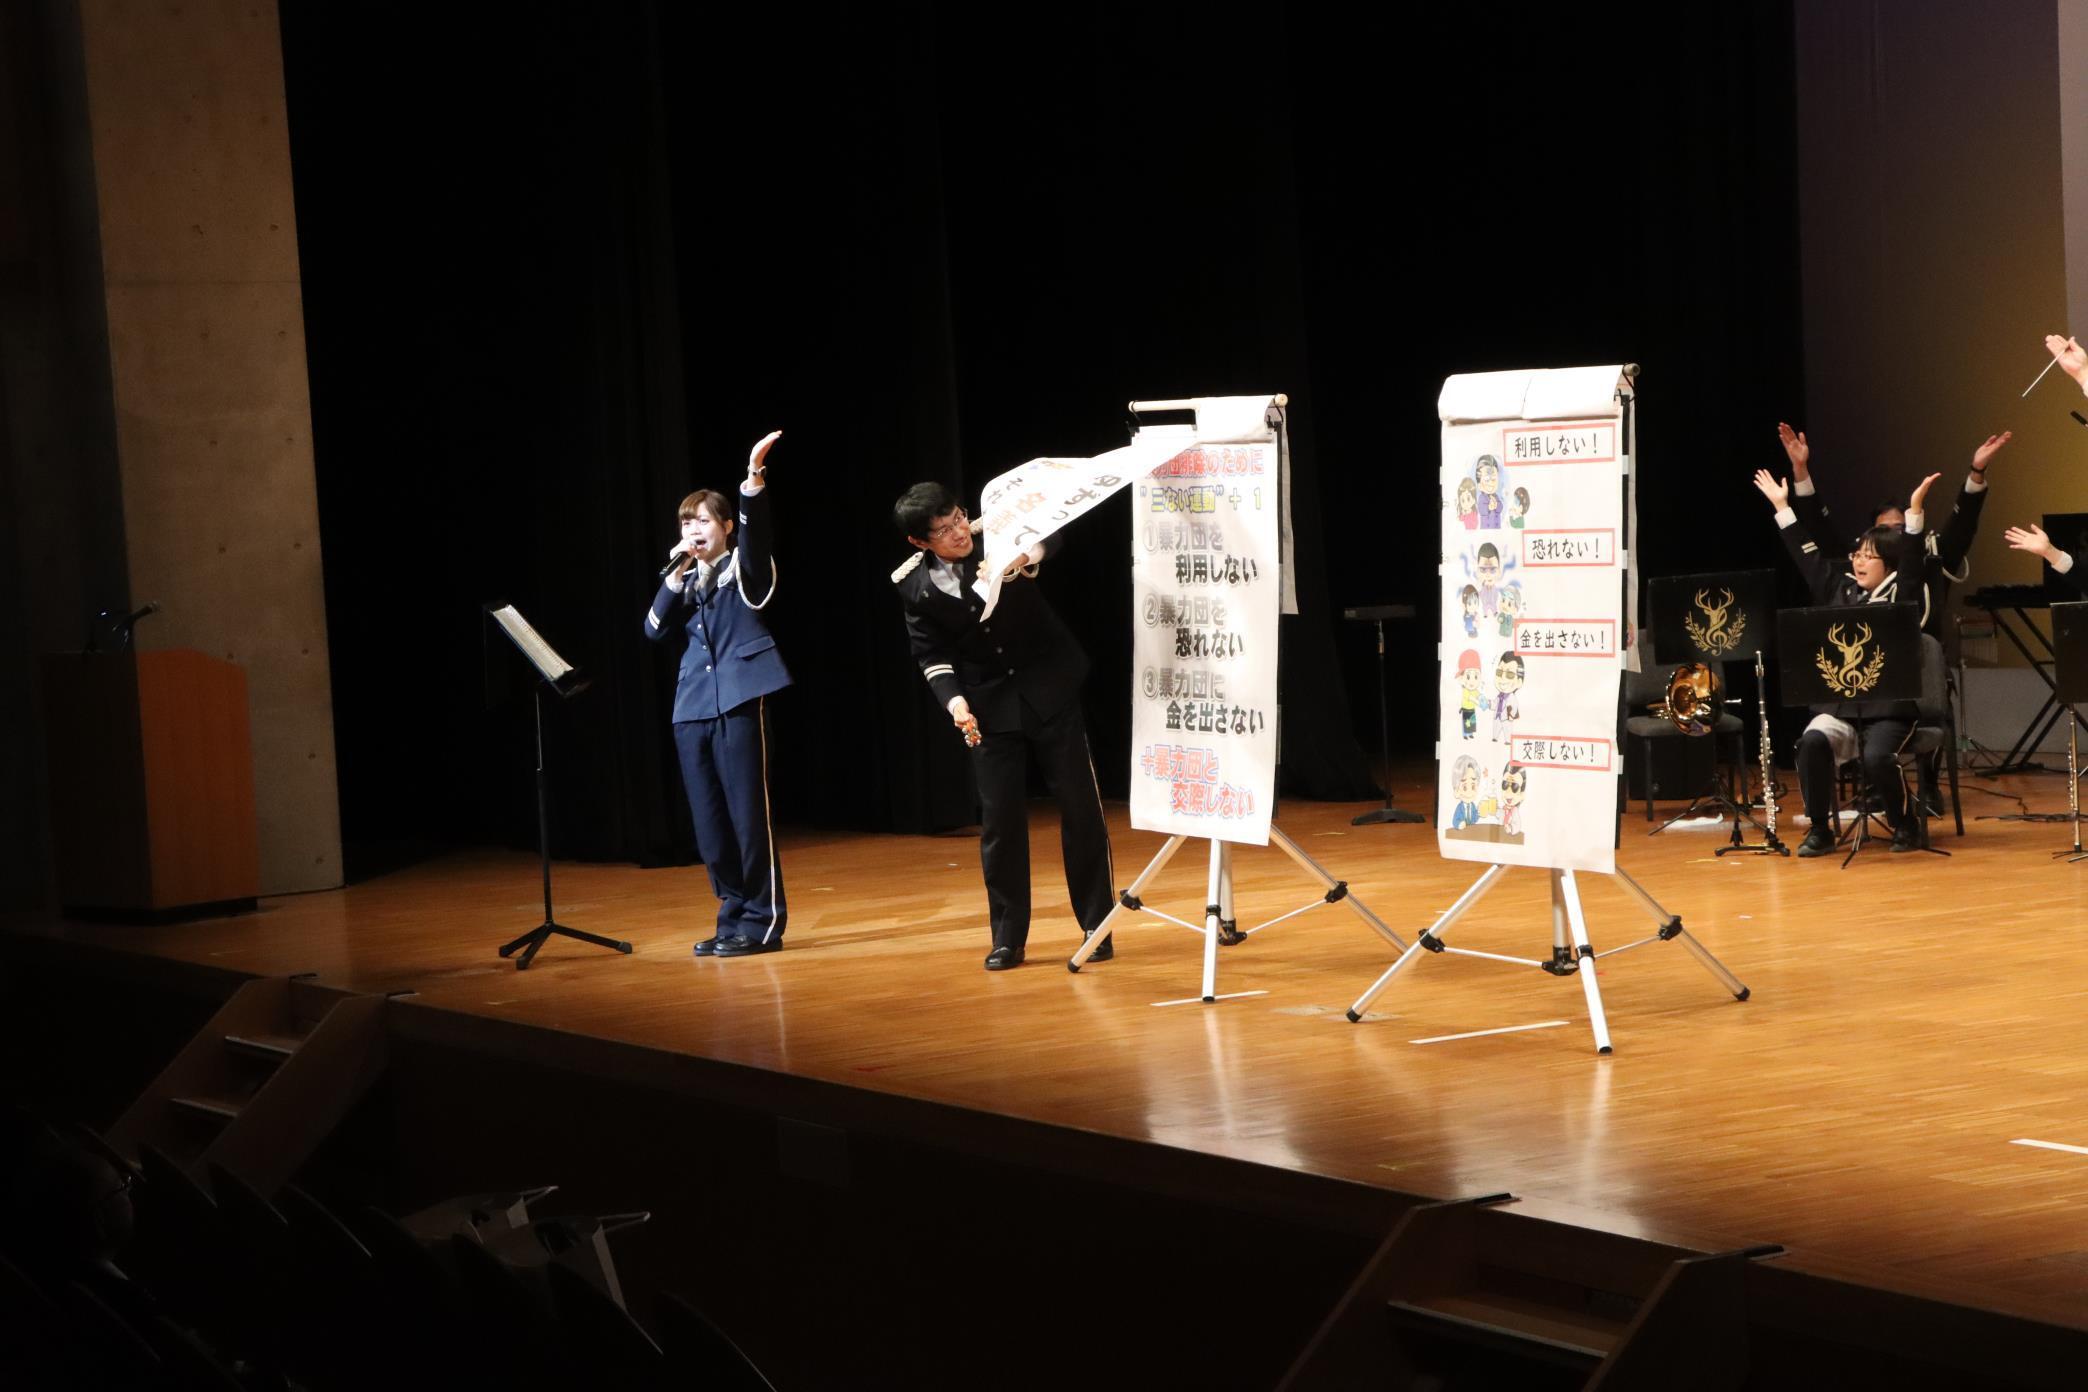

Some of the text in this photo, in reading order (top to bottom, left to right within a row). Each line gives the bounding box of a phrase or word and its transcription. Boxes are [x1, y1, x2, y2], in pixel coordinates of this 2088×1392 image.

[1146, 449, 1265, 479] 団排除のために
[1175, 554, 1258, 584] 利用しない
[1175, 627, 1244, 659] 恐れない
[1165, 701, 1264, 735] 金を出さない
[1170, 781, 1255, 818] 交際しない
